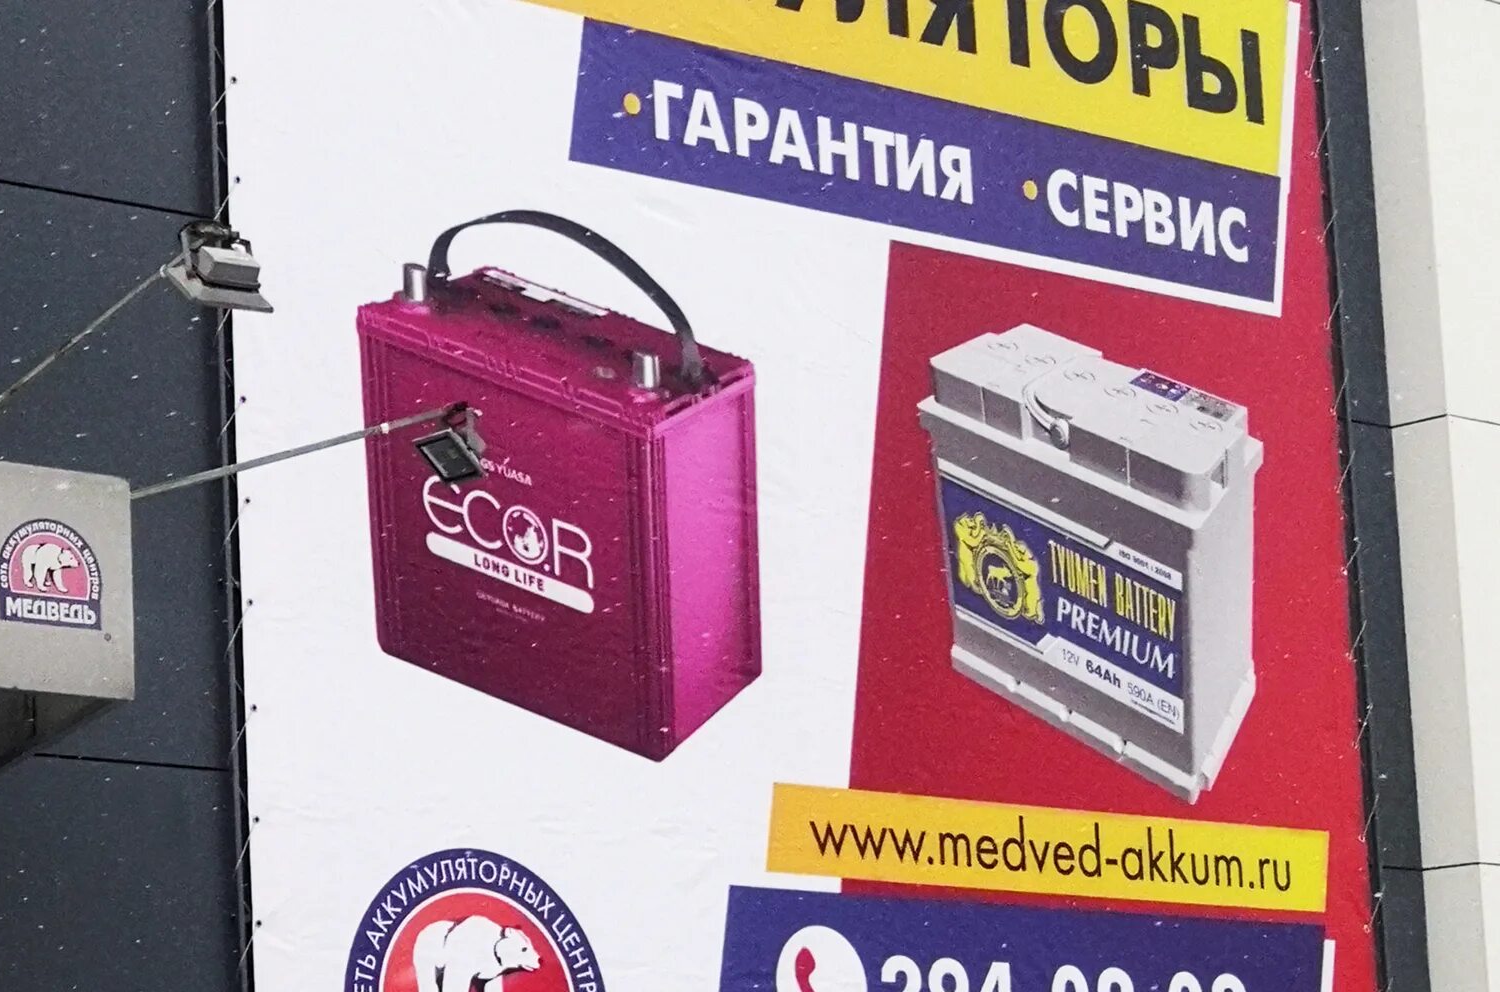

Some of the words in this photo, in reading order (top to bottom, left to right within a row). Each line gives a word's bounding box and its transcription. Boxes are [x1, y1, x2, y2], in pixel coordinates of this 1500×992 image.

[651, 79, 975, 205] ГАРАНТИЯ
[1046, 167, 1249, 263] СЕРВИС
[1, 520, 84, 560] аккумуляторных
[473, 553, 511, 577] LONG
[513, 569, 545, 592] LIFE
[5, 596, 97, 625] МЕДВЕДЬ
[1048, 540, 1108, 608] TYUMEN
[1114, 571, 1176, 642] BATTERY
[1056, 597, 1175, 680] PREMIUM
[1062, 648, 1081, 667] 12V
[1085, 659, 1122, 689] 64Ah
[1127, 682, 1155, 705] 590A
[1157, 698, 1181, 721] (EN)
[808, 816, 1294, 892] www.medved-akkum.ru
[366, 858, 556, 950] АККУМУЛЯТОРНЫХ
